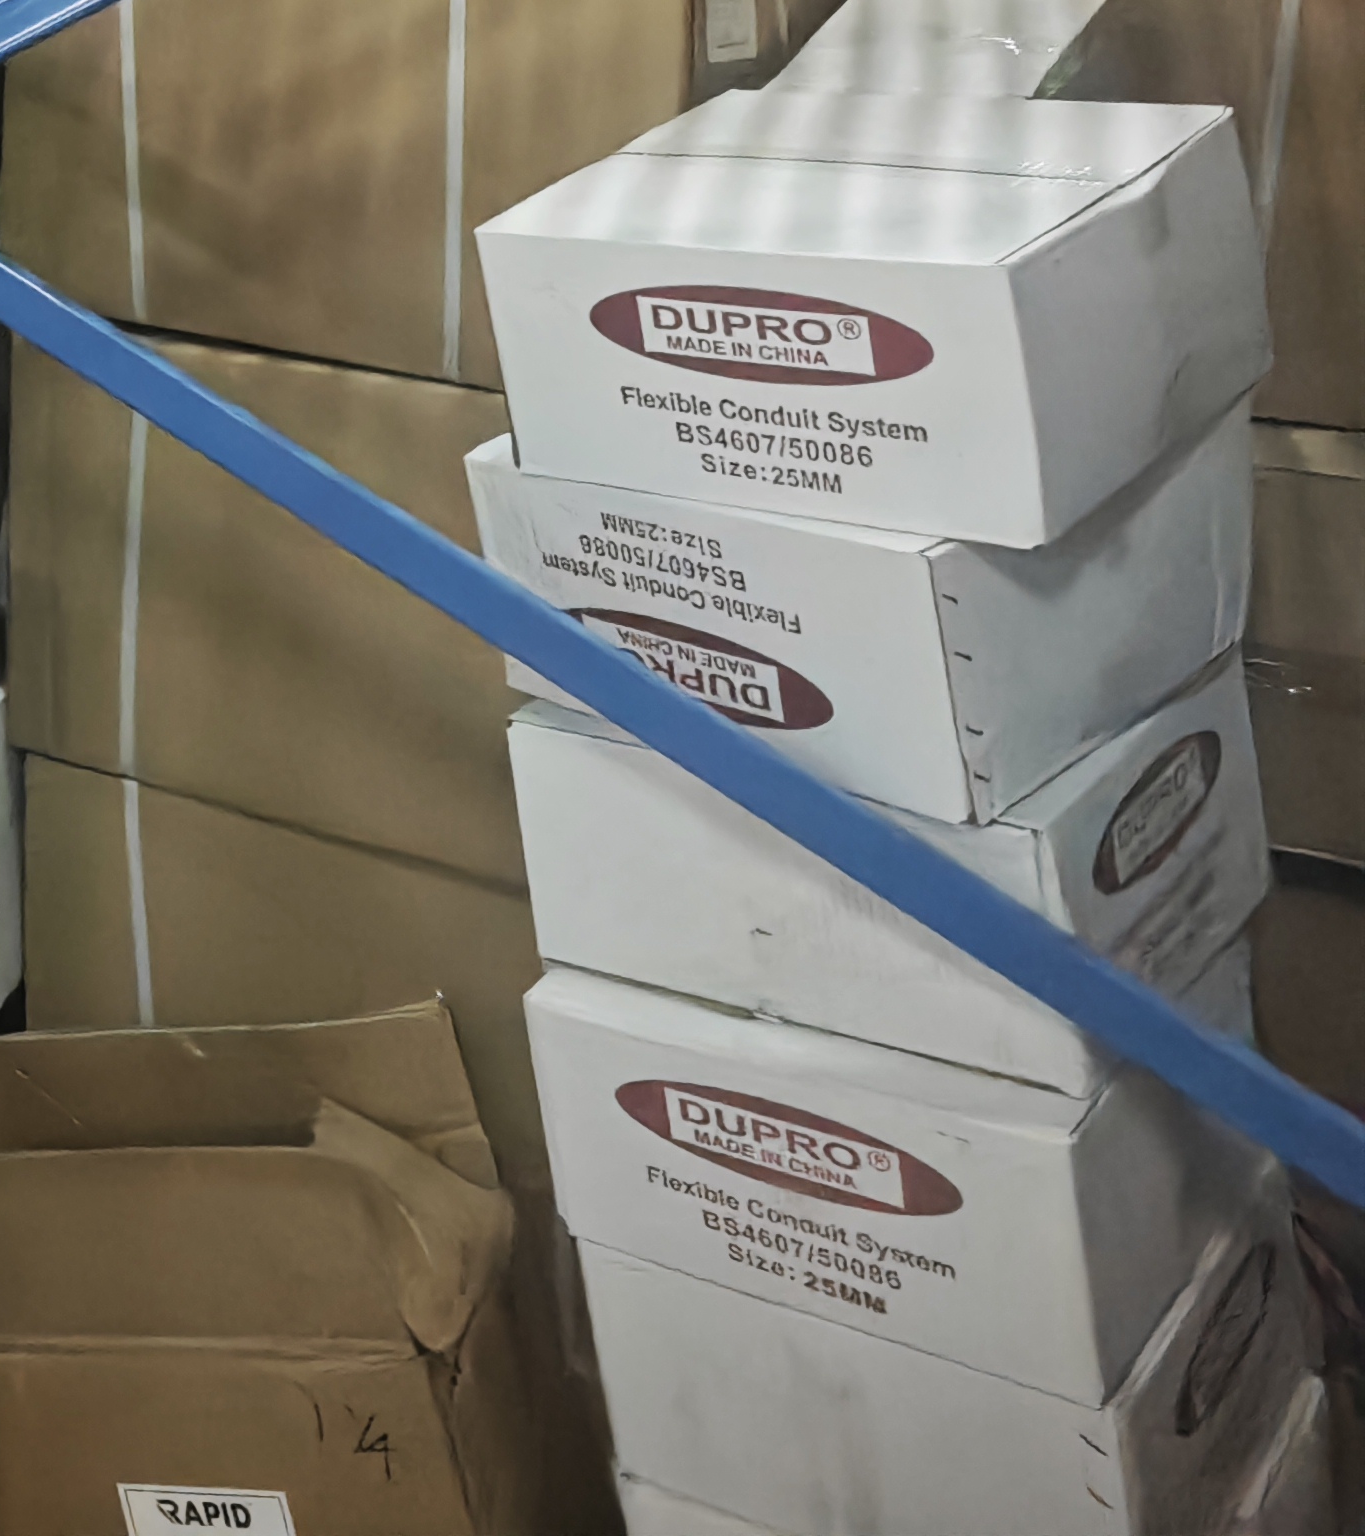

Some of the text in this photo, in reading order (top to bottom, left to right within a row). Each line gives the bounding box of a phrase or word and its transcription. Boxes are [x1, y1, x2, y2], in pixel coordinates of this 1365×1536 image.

[666, 335, 830, 367] MADE IN CHINA
[620, 386, 929, 444] Flexible Conduit System
[675, 421, 874, 468] BS4607/50086
[701, 453, 844, 495] Size:25MM
[599, 511, 723, 560] Size:25MM
[578, 534, 747, 593] BS4607/50086
[541, 551, 803, 635] Flexible Conduit System
[616, 627, 757, 680] MADE IN CHINA
[694, 1129, 858, 1191] MADE IN CHINA
[645, 1165, 958, 1280] Flexible Conduit System
[702, 1209, 903, 1291] BS4607/50086
[156, 1498, 252, 1530] RAPID
